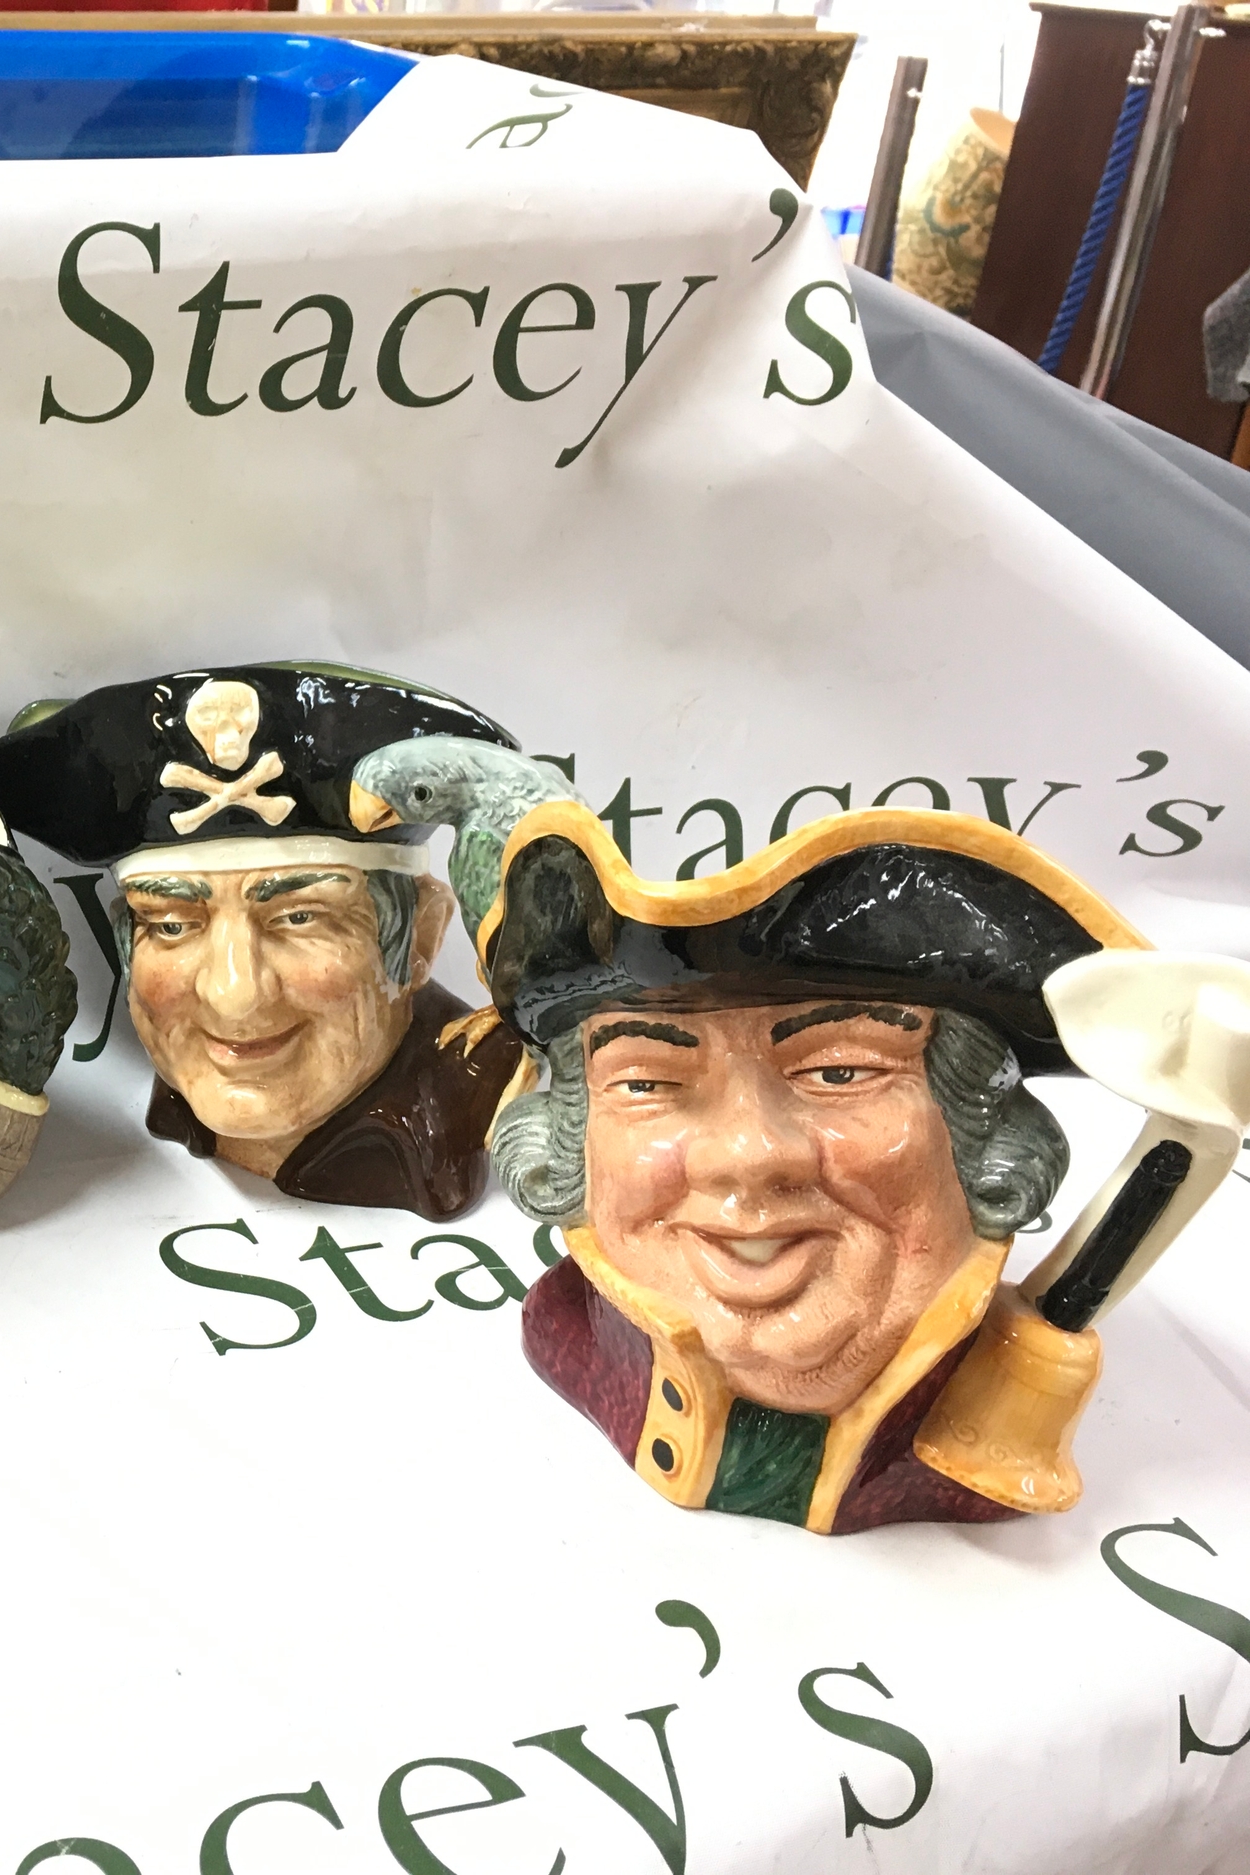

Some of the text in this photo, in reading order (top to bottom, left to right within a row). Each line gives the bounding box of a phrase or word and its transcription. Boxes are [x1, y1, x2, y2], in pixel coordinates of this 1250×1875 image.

[39, 188, 857, 469] Stacey's
[529, 749, 1226, 882] tay's
[158, 1217, 570, 1356] Sta
